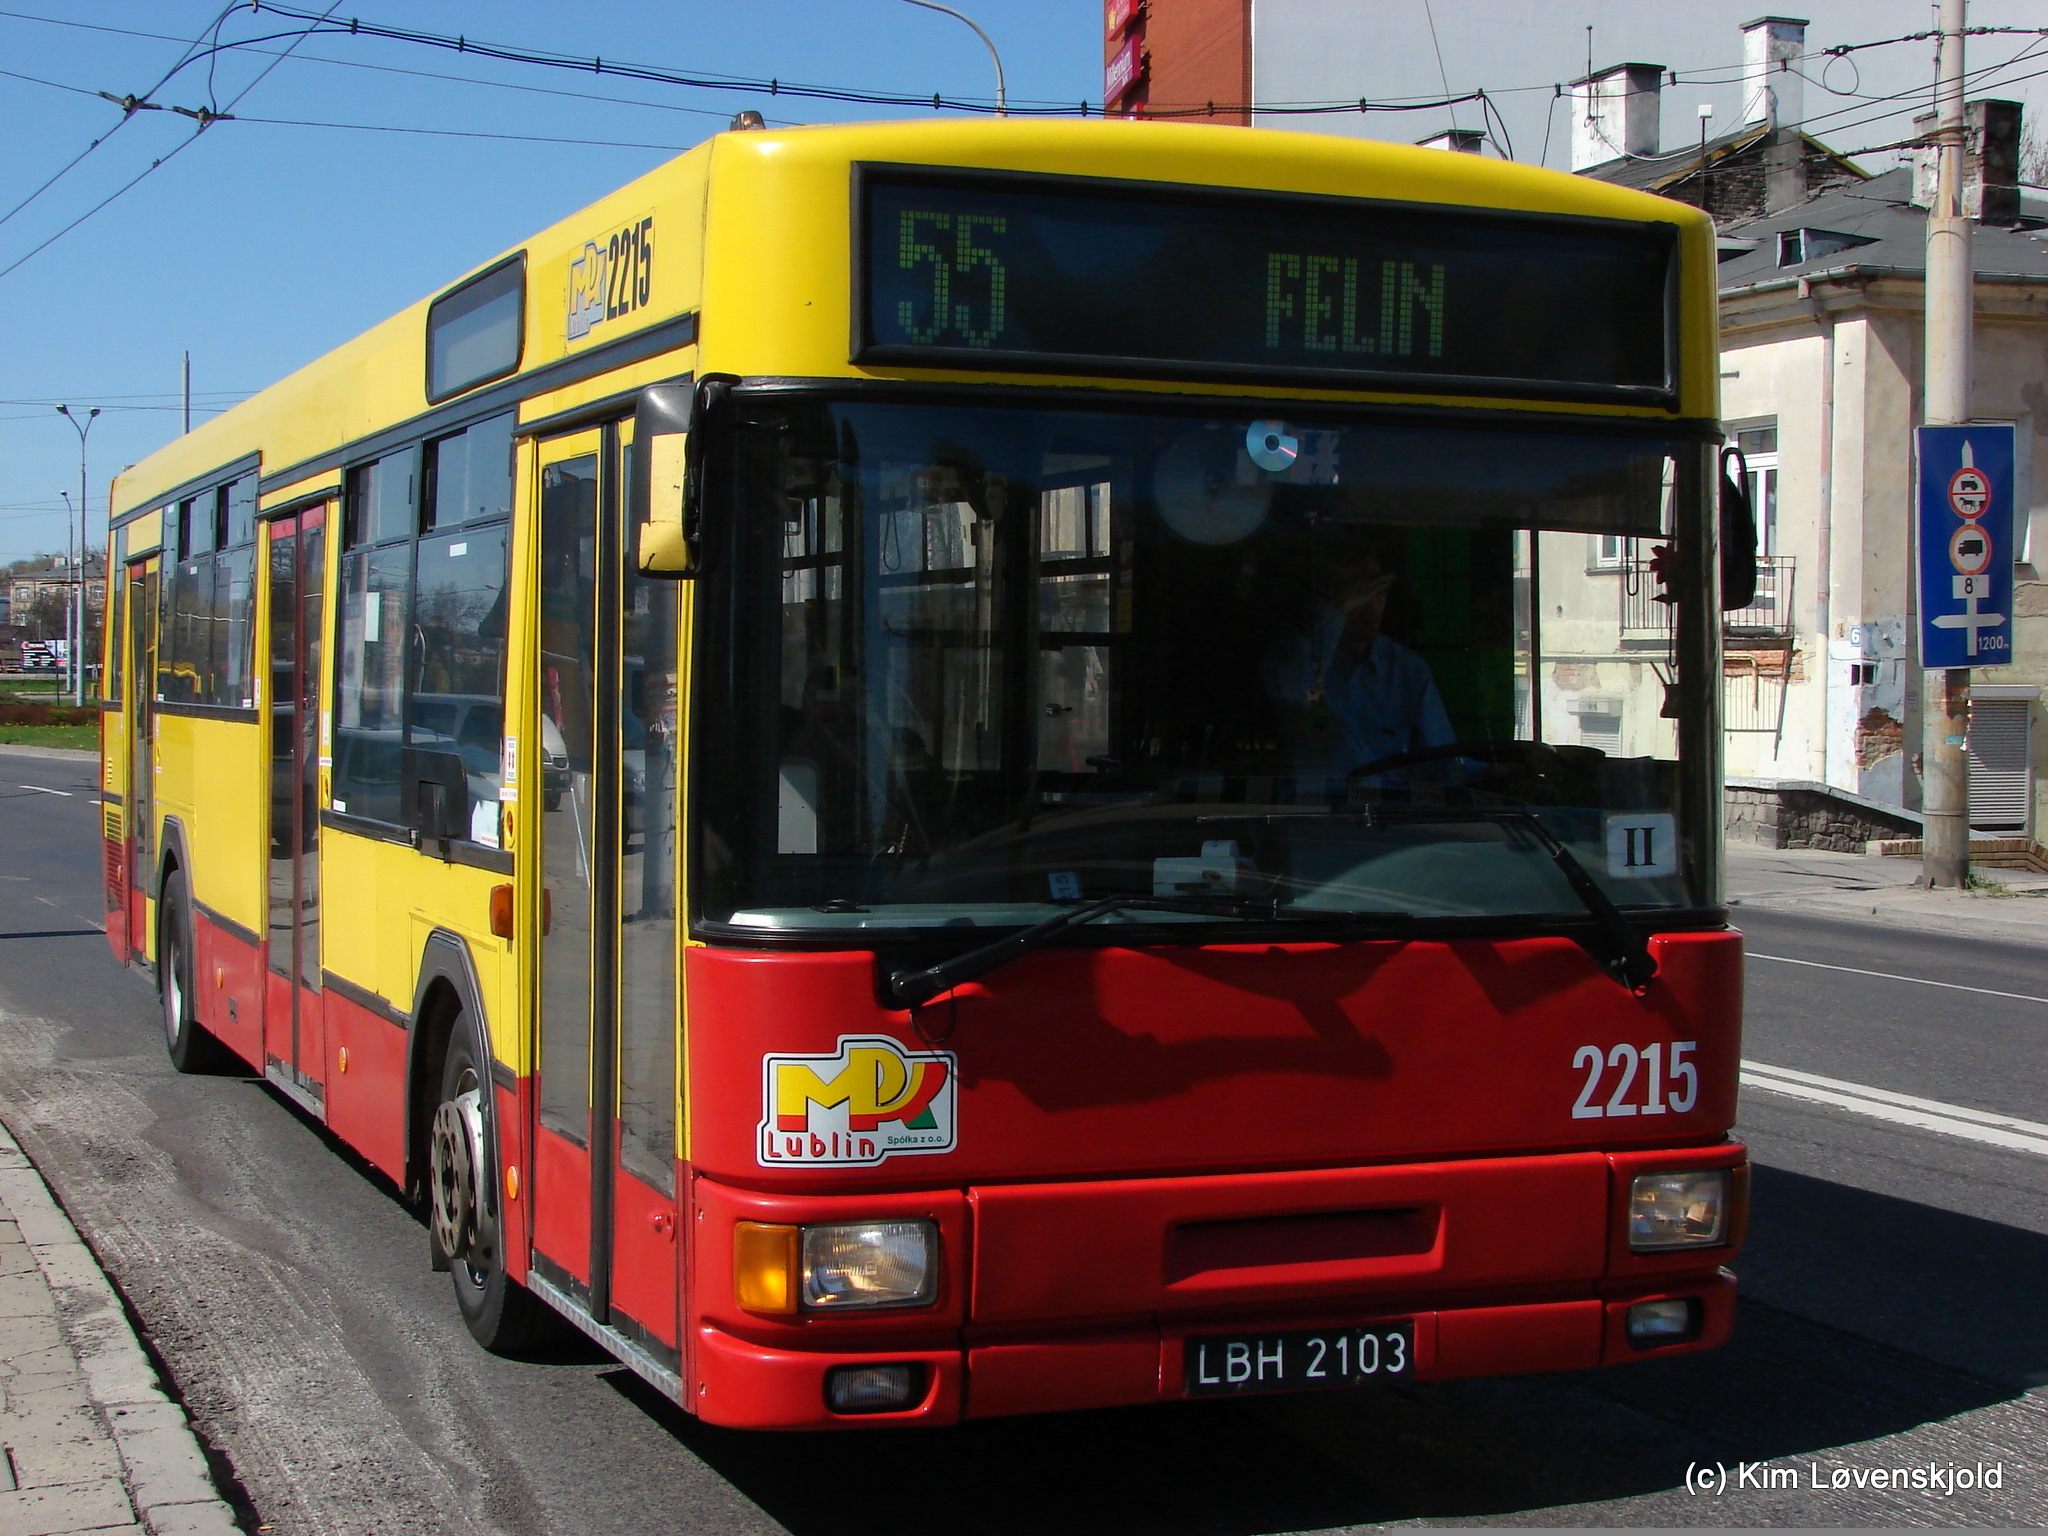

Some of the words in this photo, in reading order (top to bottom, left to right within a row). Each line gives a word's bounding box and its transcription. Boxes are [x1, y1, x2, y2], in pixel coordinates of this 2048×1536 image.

[606, 216, 653, 322] 2215
[899, 210, 1006, 348] 55
[1265, 252, 1445, 358] FELIN
[1851, 627, 1861, 645] 6
[776, 1047, 949, 1132] MPK
[1571, 1040, 1698, 1119] 2215
[767, 1131, 875, 1158] Lublin
[887, 1135, 918, 1146] Spółka
[920, 1136, 926, 1144] z
[928, 1135, 945, 1143] o.o.
[1199, 1339, 1284, 1384] LBH
[1306, 1332, 1407, 1378] 2103
